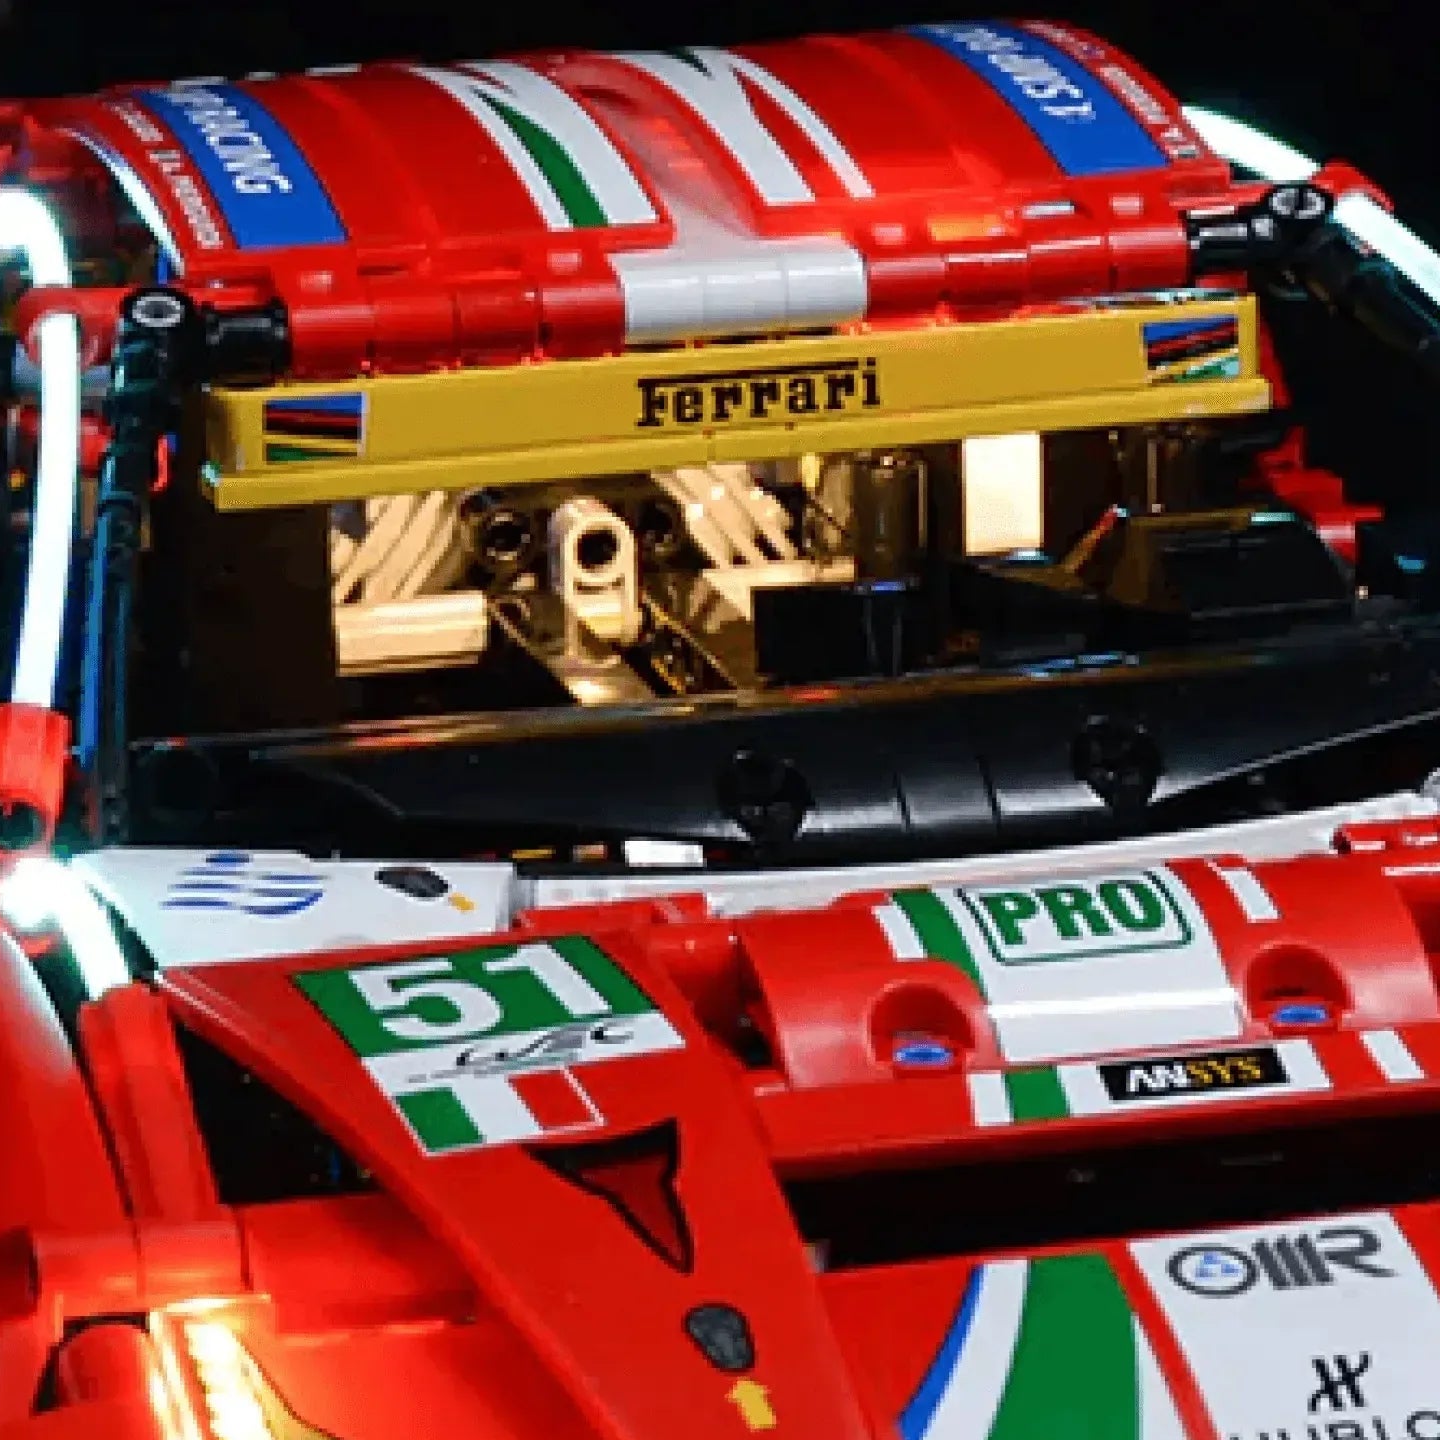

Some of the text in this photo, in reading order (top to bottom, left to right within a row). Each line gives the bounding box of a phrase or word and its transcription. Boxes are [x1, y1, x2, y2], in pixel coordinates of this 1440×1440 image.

[635, 358, 882, 428] Ferrari
[978, 879, 1166, 946] PRO
[348, 943, 614, 1039] 51
[1125, 1056, 1264, 1093] ANSYS
